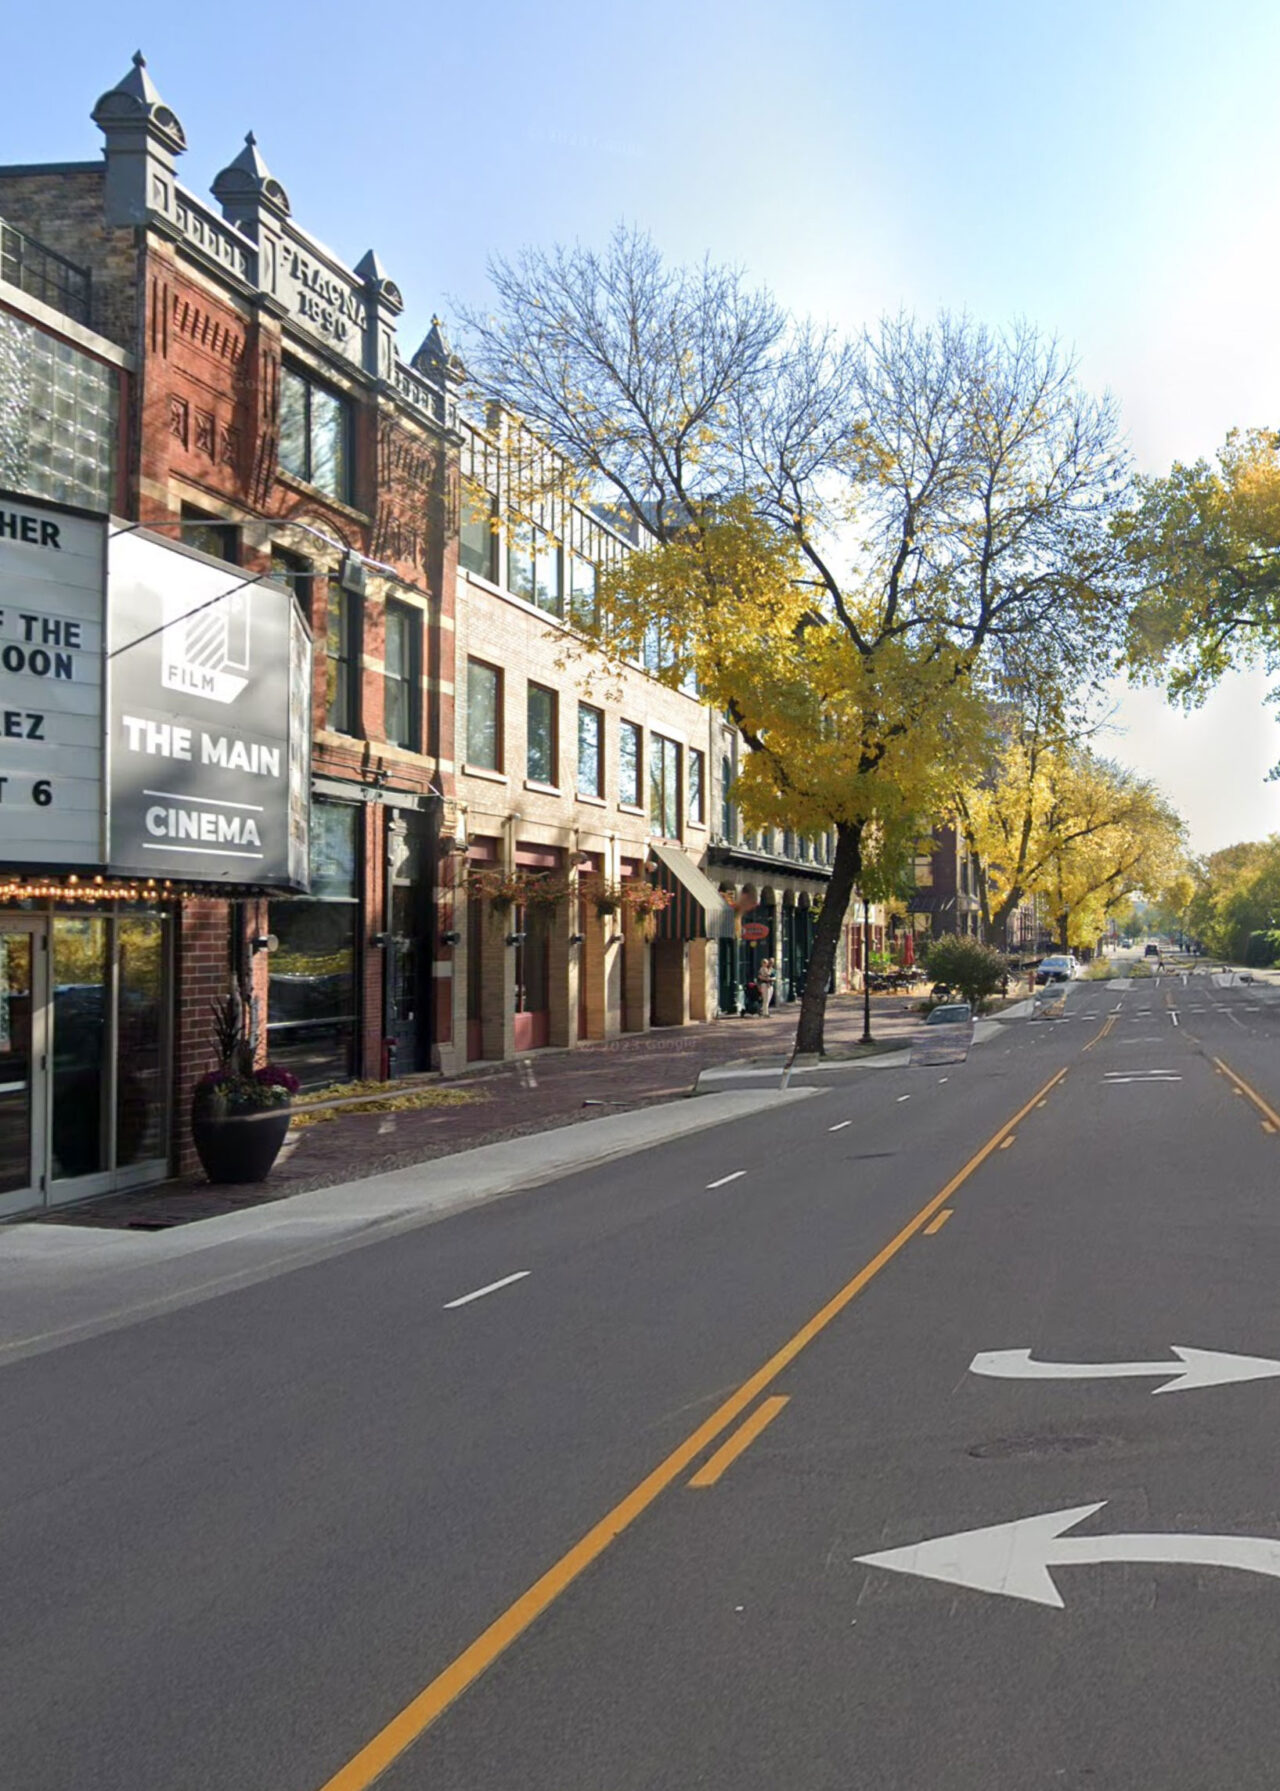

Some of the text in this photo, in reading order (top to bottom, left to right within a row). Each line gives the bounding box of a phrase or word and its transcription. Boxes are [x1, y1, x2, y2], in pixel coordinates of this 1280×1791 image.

[297, 291, 346, 341] 1890
[0, 511, 61, 549] HER
[19, 613, 81, 649] THE
[3, 645, 72, 680] OON
[169, 664, 214, 692] FILM
[0, 711, 45, 741] EZ
[122, 715, 280, 778] THE MAIN
[32, 780, 53, 807] 6
[145, 806, 261, 846] CINEMA
